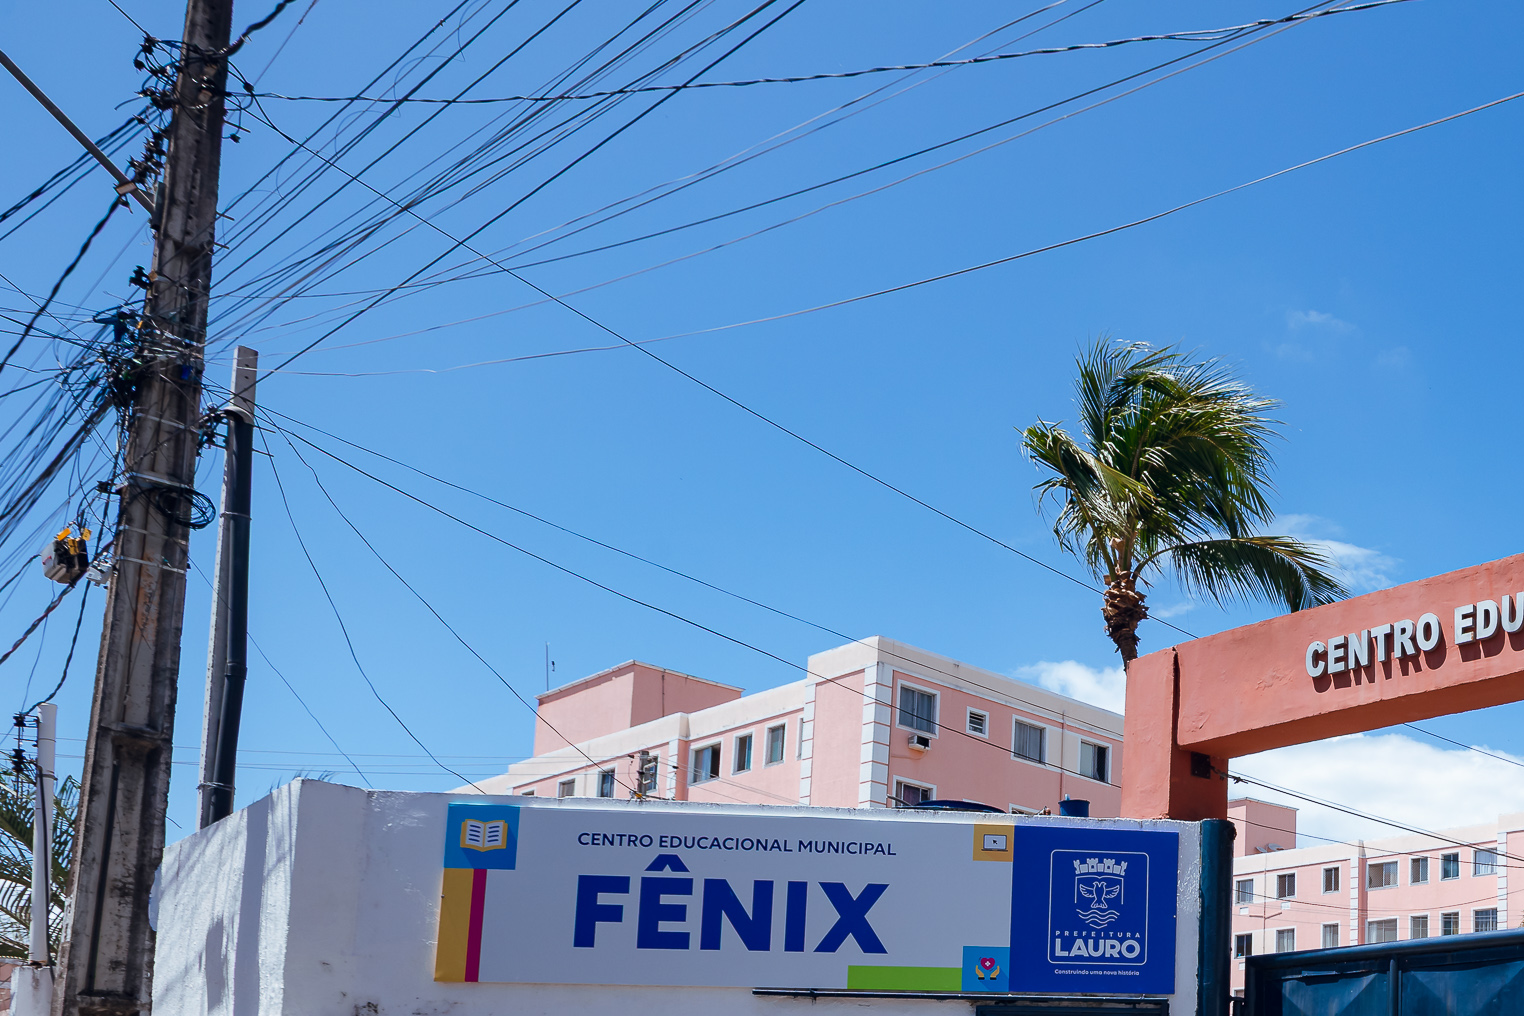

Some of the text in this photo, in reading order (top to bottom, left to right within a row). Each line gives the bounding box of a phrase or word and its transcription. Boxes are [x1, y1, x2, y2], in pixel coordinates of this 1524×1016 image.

[1305, 612, 1441, 678] CENTRO
[577, 832, 897, 855] CENTRO EDUCACIONAL MUNICIPAL
[573, 853, 890, 954] FÊNIX
[1055, 930, 1140, 938] PREFEITURA
[1055, 938, 1140, 958] LAURO
